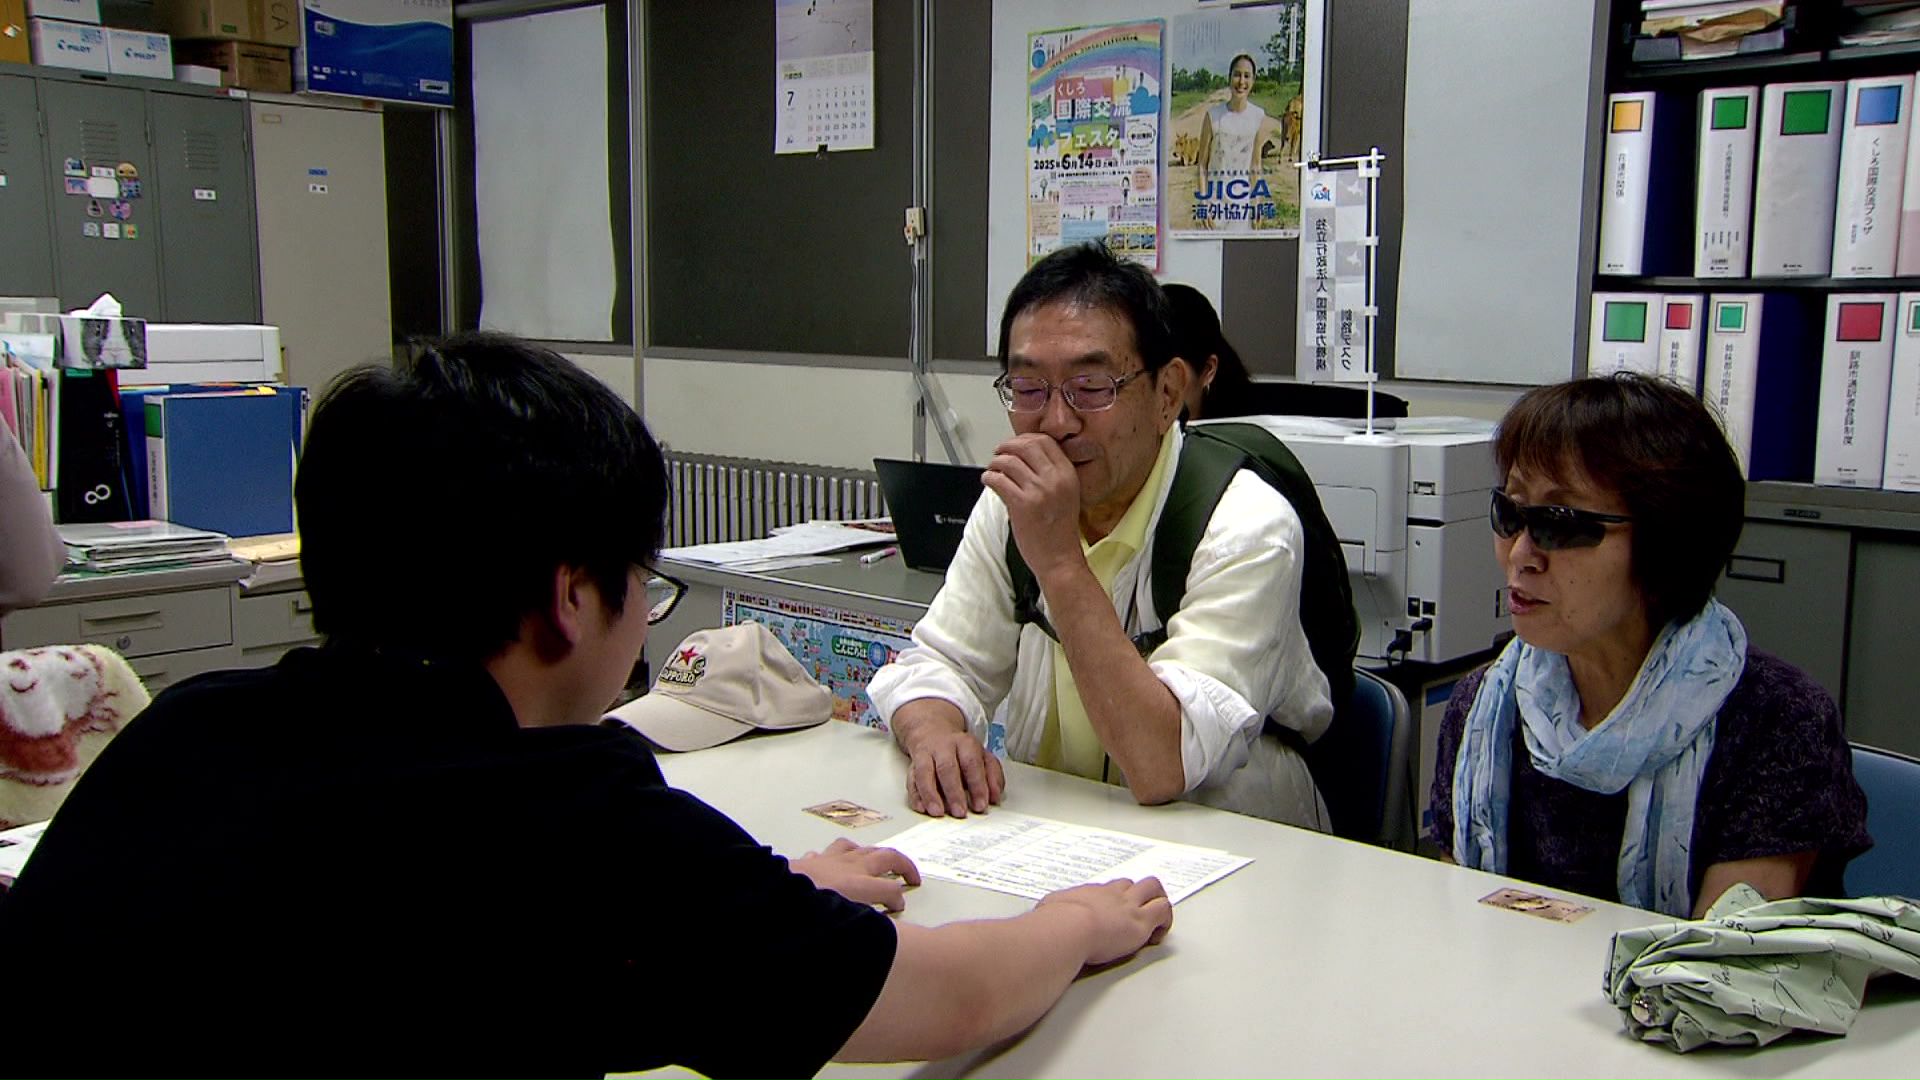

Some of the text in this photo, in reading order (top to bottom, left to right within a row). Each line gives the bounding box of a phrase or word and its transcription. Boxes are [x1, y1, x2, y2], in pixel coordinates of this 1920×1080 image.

[67, 44, 91, 53] PILOT
[1058, 82, 1085, 96] くしろ
[787, 90, 794, 106] 7
[1056, 97, 1132, 120] 国際交流
[1059, 128, 1120, 147] フェスタ
[1194, 179, 1272, 200] JICA
[1192, 203, 1276, 220] 海外協力隊
